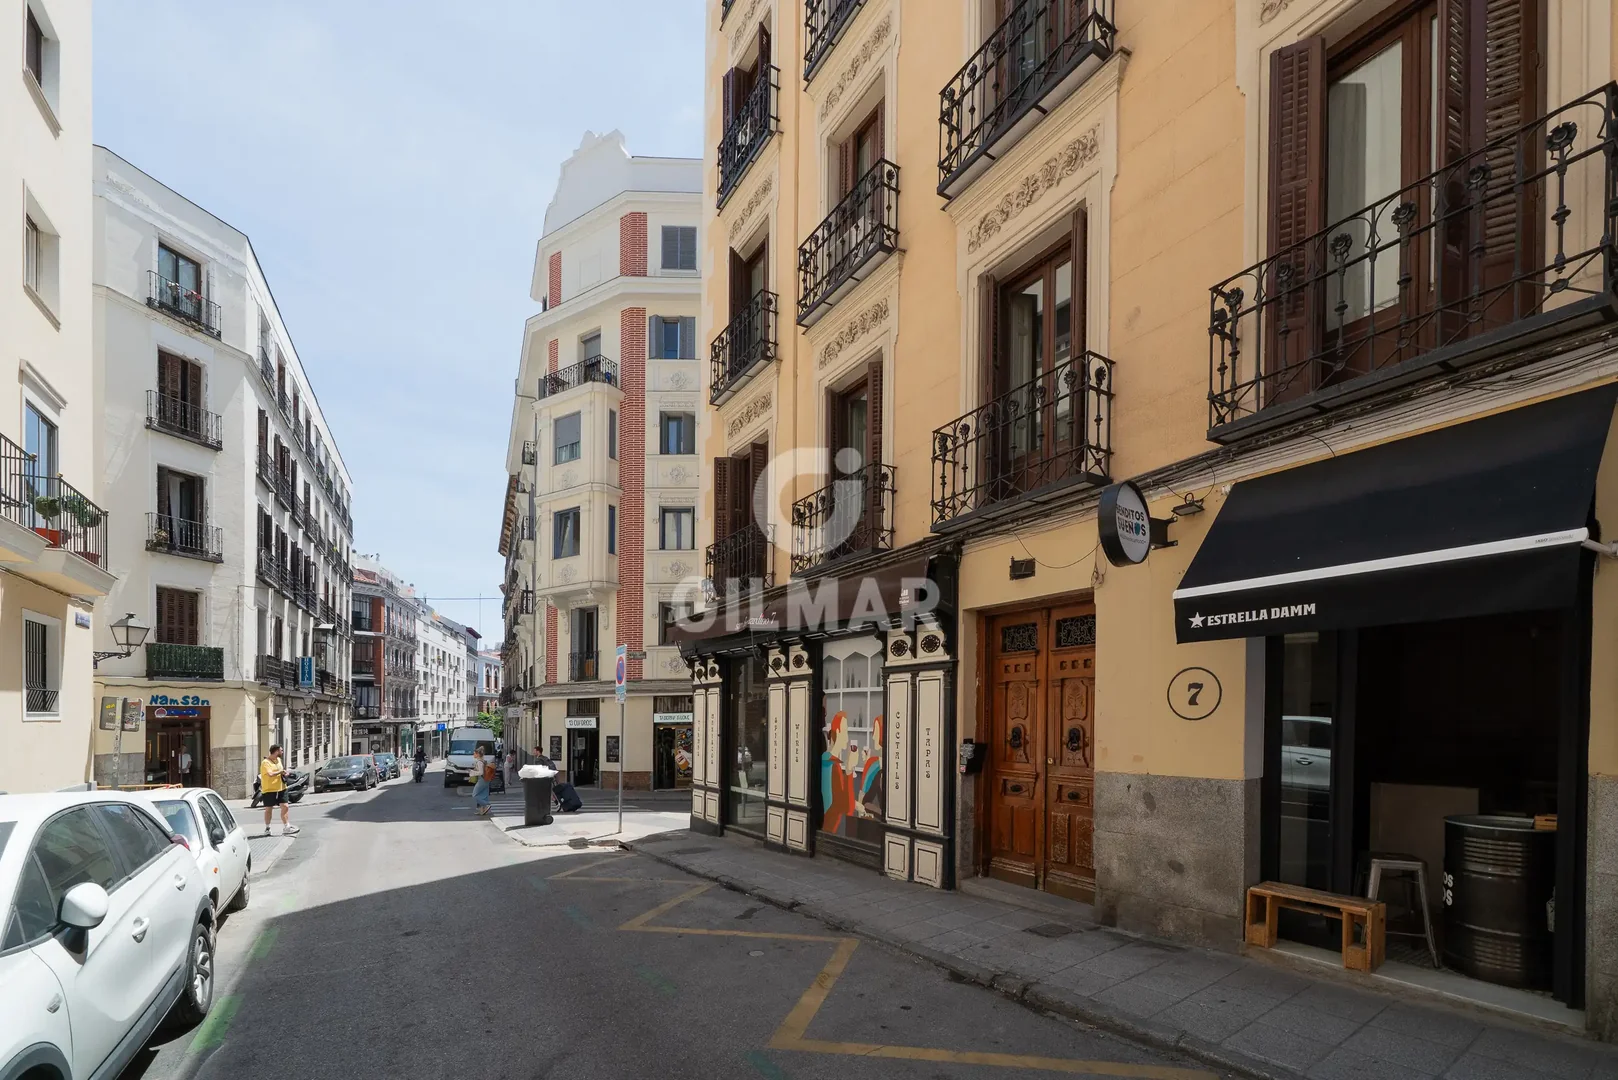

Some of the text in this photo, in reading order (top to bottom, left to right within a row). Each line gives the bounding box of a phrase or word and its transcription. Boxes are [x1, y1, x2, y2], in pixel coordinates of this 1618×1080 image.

[1207, 603, 1316, 626] ESTRELLA DAMM
[1187, 682, 1204, 706] 7
